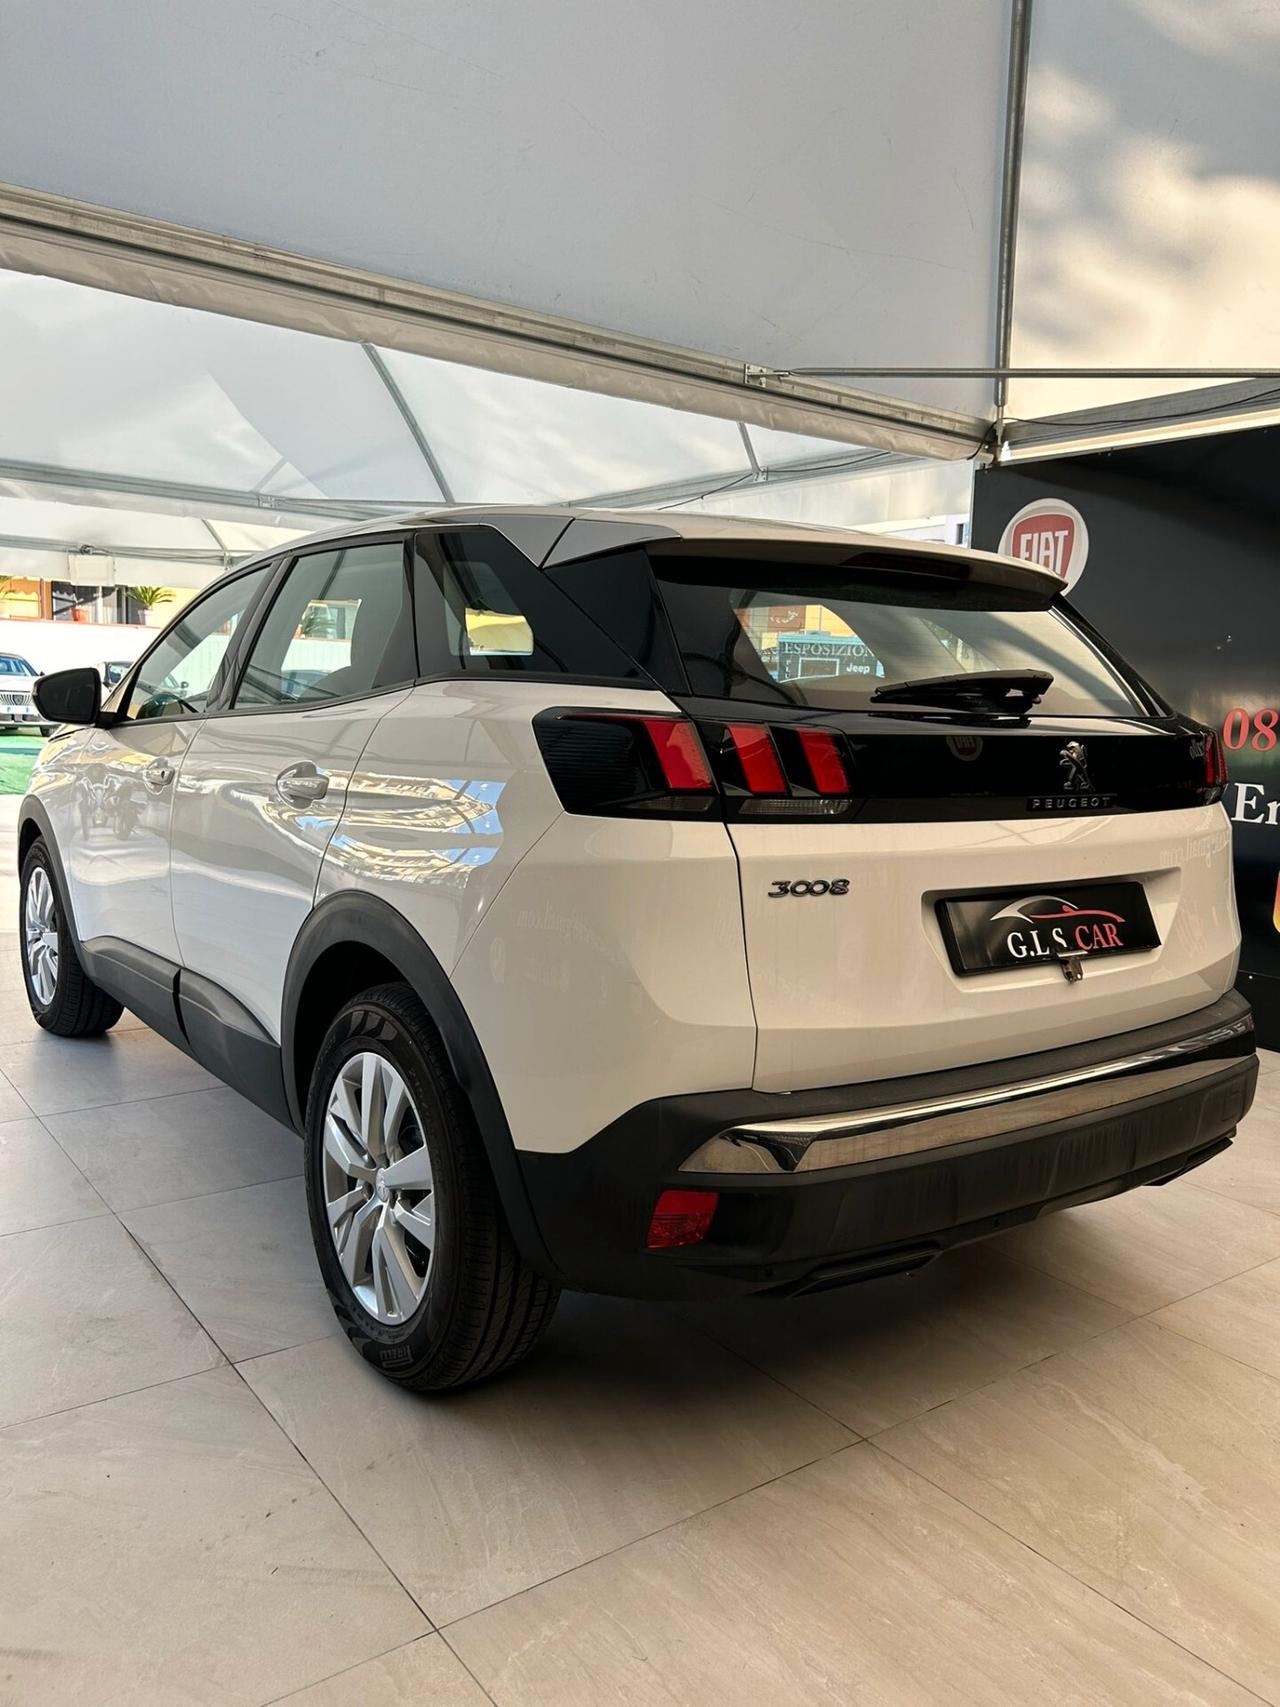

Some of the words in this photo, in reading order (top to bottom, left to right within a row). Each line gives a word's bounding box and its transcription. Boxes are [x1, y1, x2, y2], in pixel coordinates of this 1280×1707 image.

[1020, 530, 1068, 575] FIAT
[846, 663, 871, 674] Jeep
[1222, 707, 1279, 752] 08
[1031, 797, 1111, 809] PEUGEOT
[768, 879, 850, 898] 3008
[1074, 923, 1124, 951] CAR
